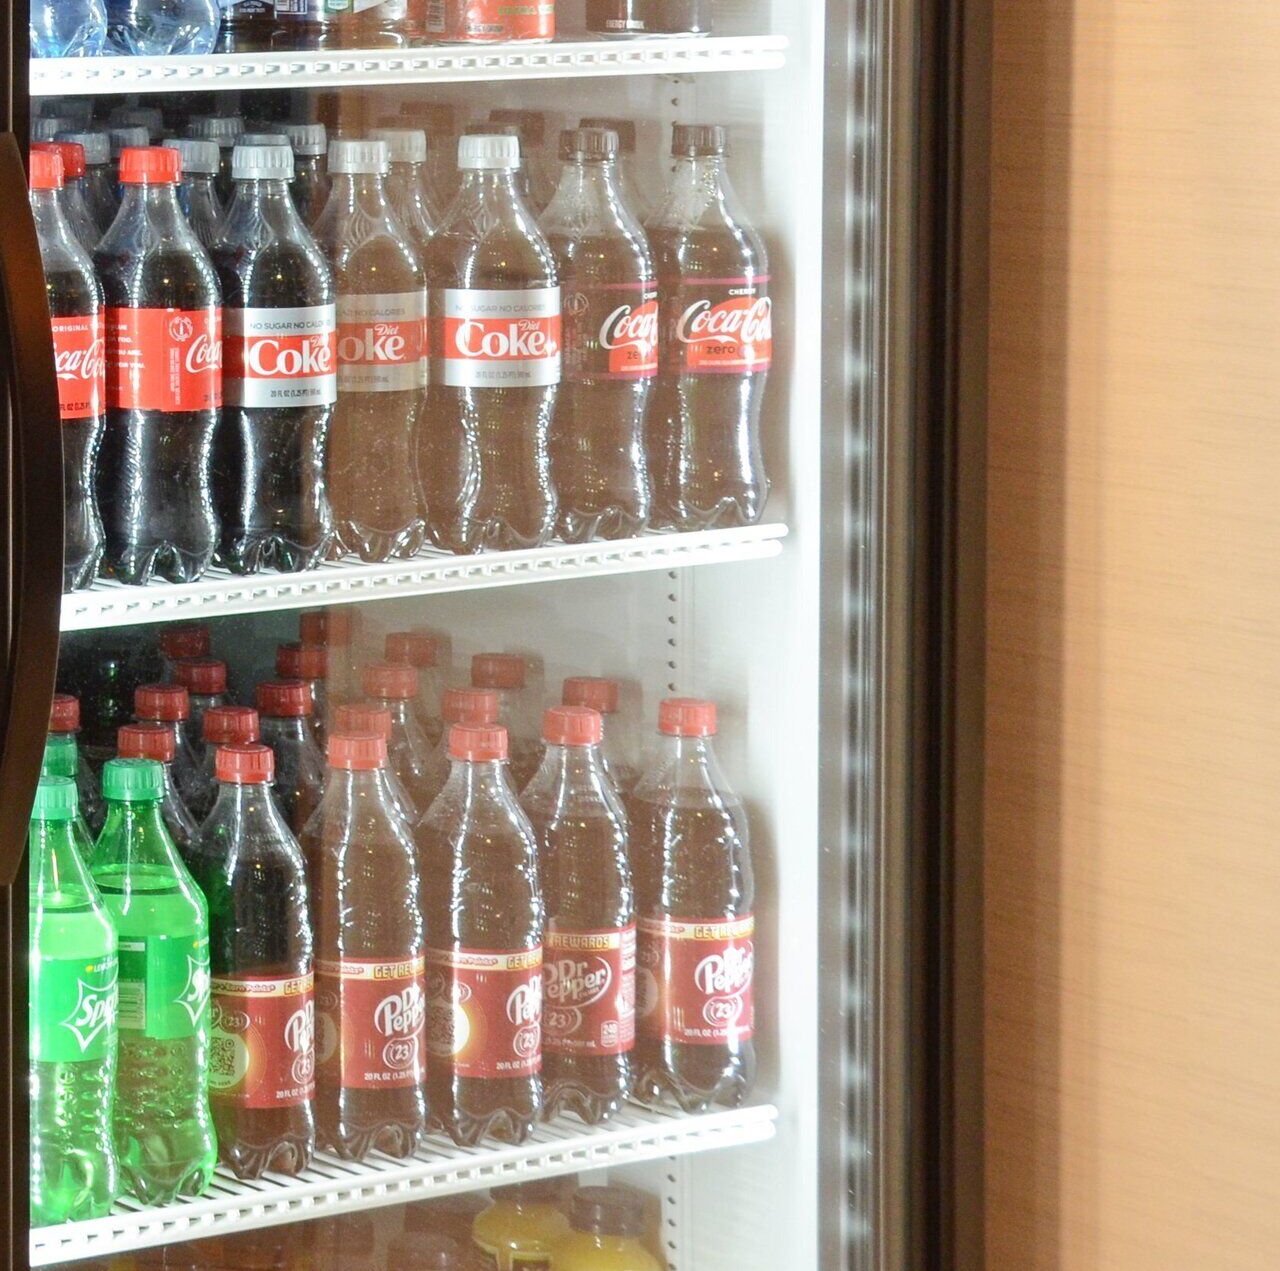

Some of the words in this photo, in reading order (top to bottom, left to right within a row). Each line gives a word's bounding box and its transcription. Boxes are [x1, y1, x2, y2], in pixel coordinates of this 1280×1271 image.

[729, 288, 756, 296] CHERRY
[52, 324, 88, 333] ORIGINAL
[264, 322, 293, 330] SUGAR
[375, 324, 400, 336] Diet
[519, 320, 541, 333] Diet
[456, 322, 547, 359] Coke
[249, 339, 331, 376] Coke
[706, 345, 735, 355] zero
[552, 935, 610, 950] REWARDS
[714, 1003, 731, 1018] 23
[548, 1013, 566, 1028] 23
[521, 1033, 537, 1049] 23
[393, 1044, 411, 1060] 23
